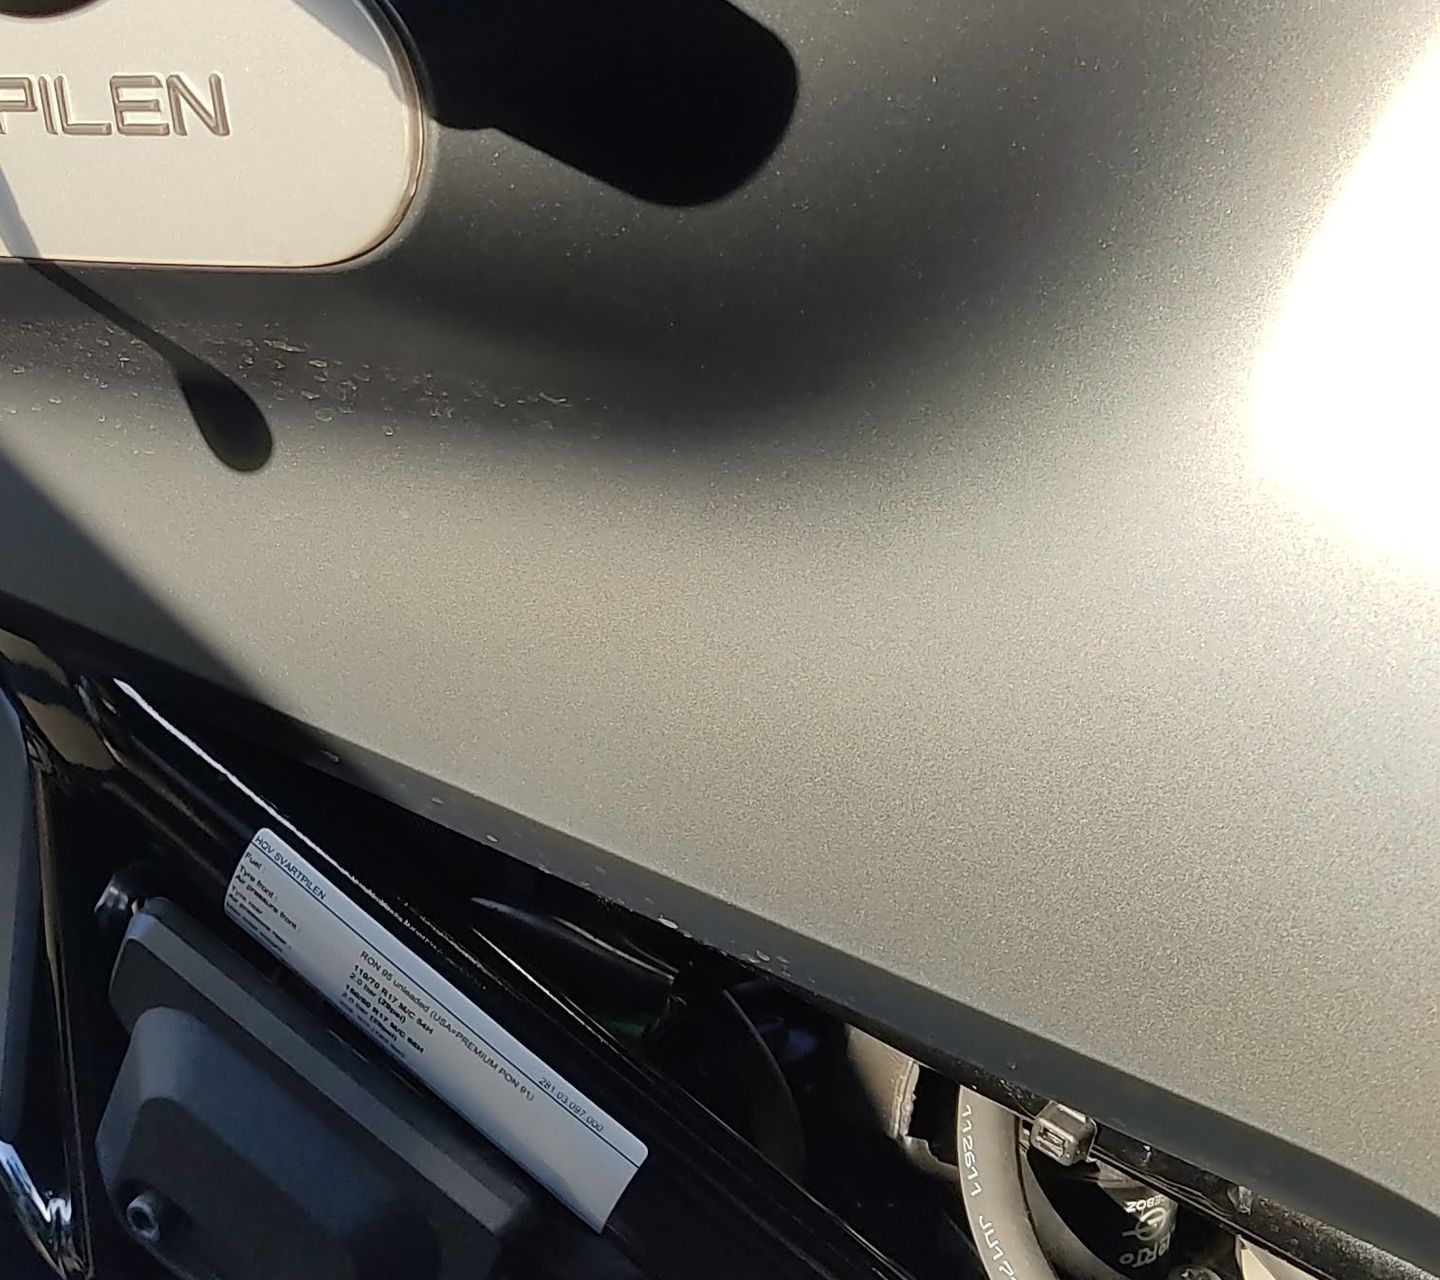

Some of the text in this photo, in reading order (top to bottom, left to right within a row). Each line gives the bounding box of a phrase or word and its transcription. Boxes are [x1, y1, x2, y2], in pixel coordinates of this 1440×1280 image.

[240, 864, 255, 882] Tyre
[254, 835, 274, 854] HQV
[274, 852, 327, 900] SVARTPILEN
[245, 852, 262, 870] Fuel
[360, 951, 381, 971] RON
[393, 980, 430, 1012] unleaded
[498, 1067, 520, 1089] PON
